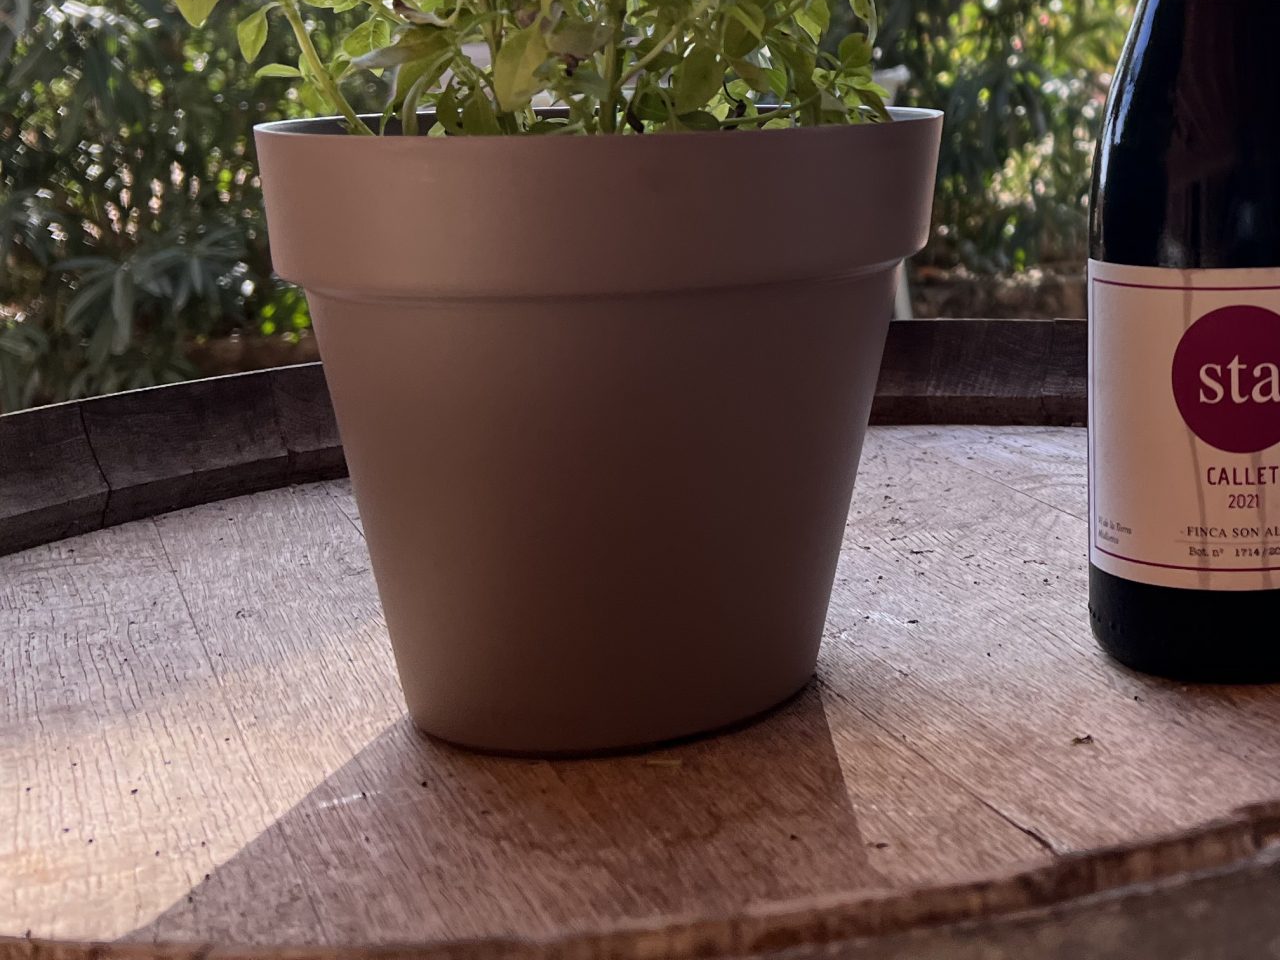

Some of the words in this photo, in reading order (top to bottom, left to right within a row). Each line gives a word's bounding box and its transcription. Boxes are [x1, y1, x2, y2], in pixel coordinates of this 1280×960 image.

[1207, 466, 1279, 486] CALLET
[1228, 494, 1260, 509] 2021
[1187, 526, 1227, 538] FINCA
[1232, 526, 1259, 538] SON
